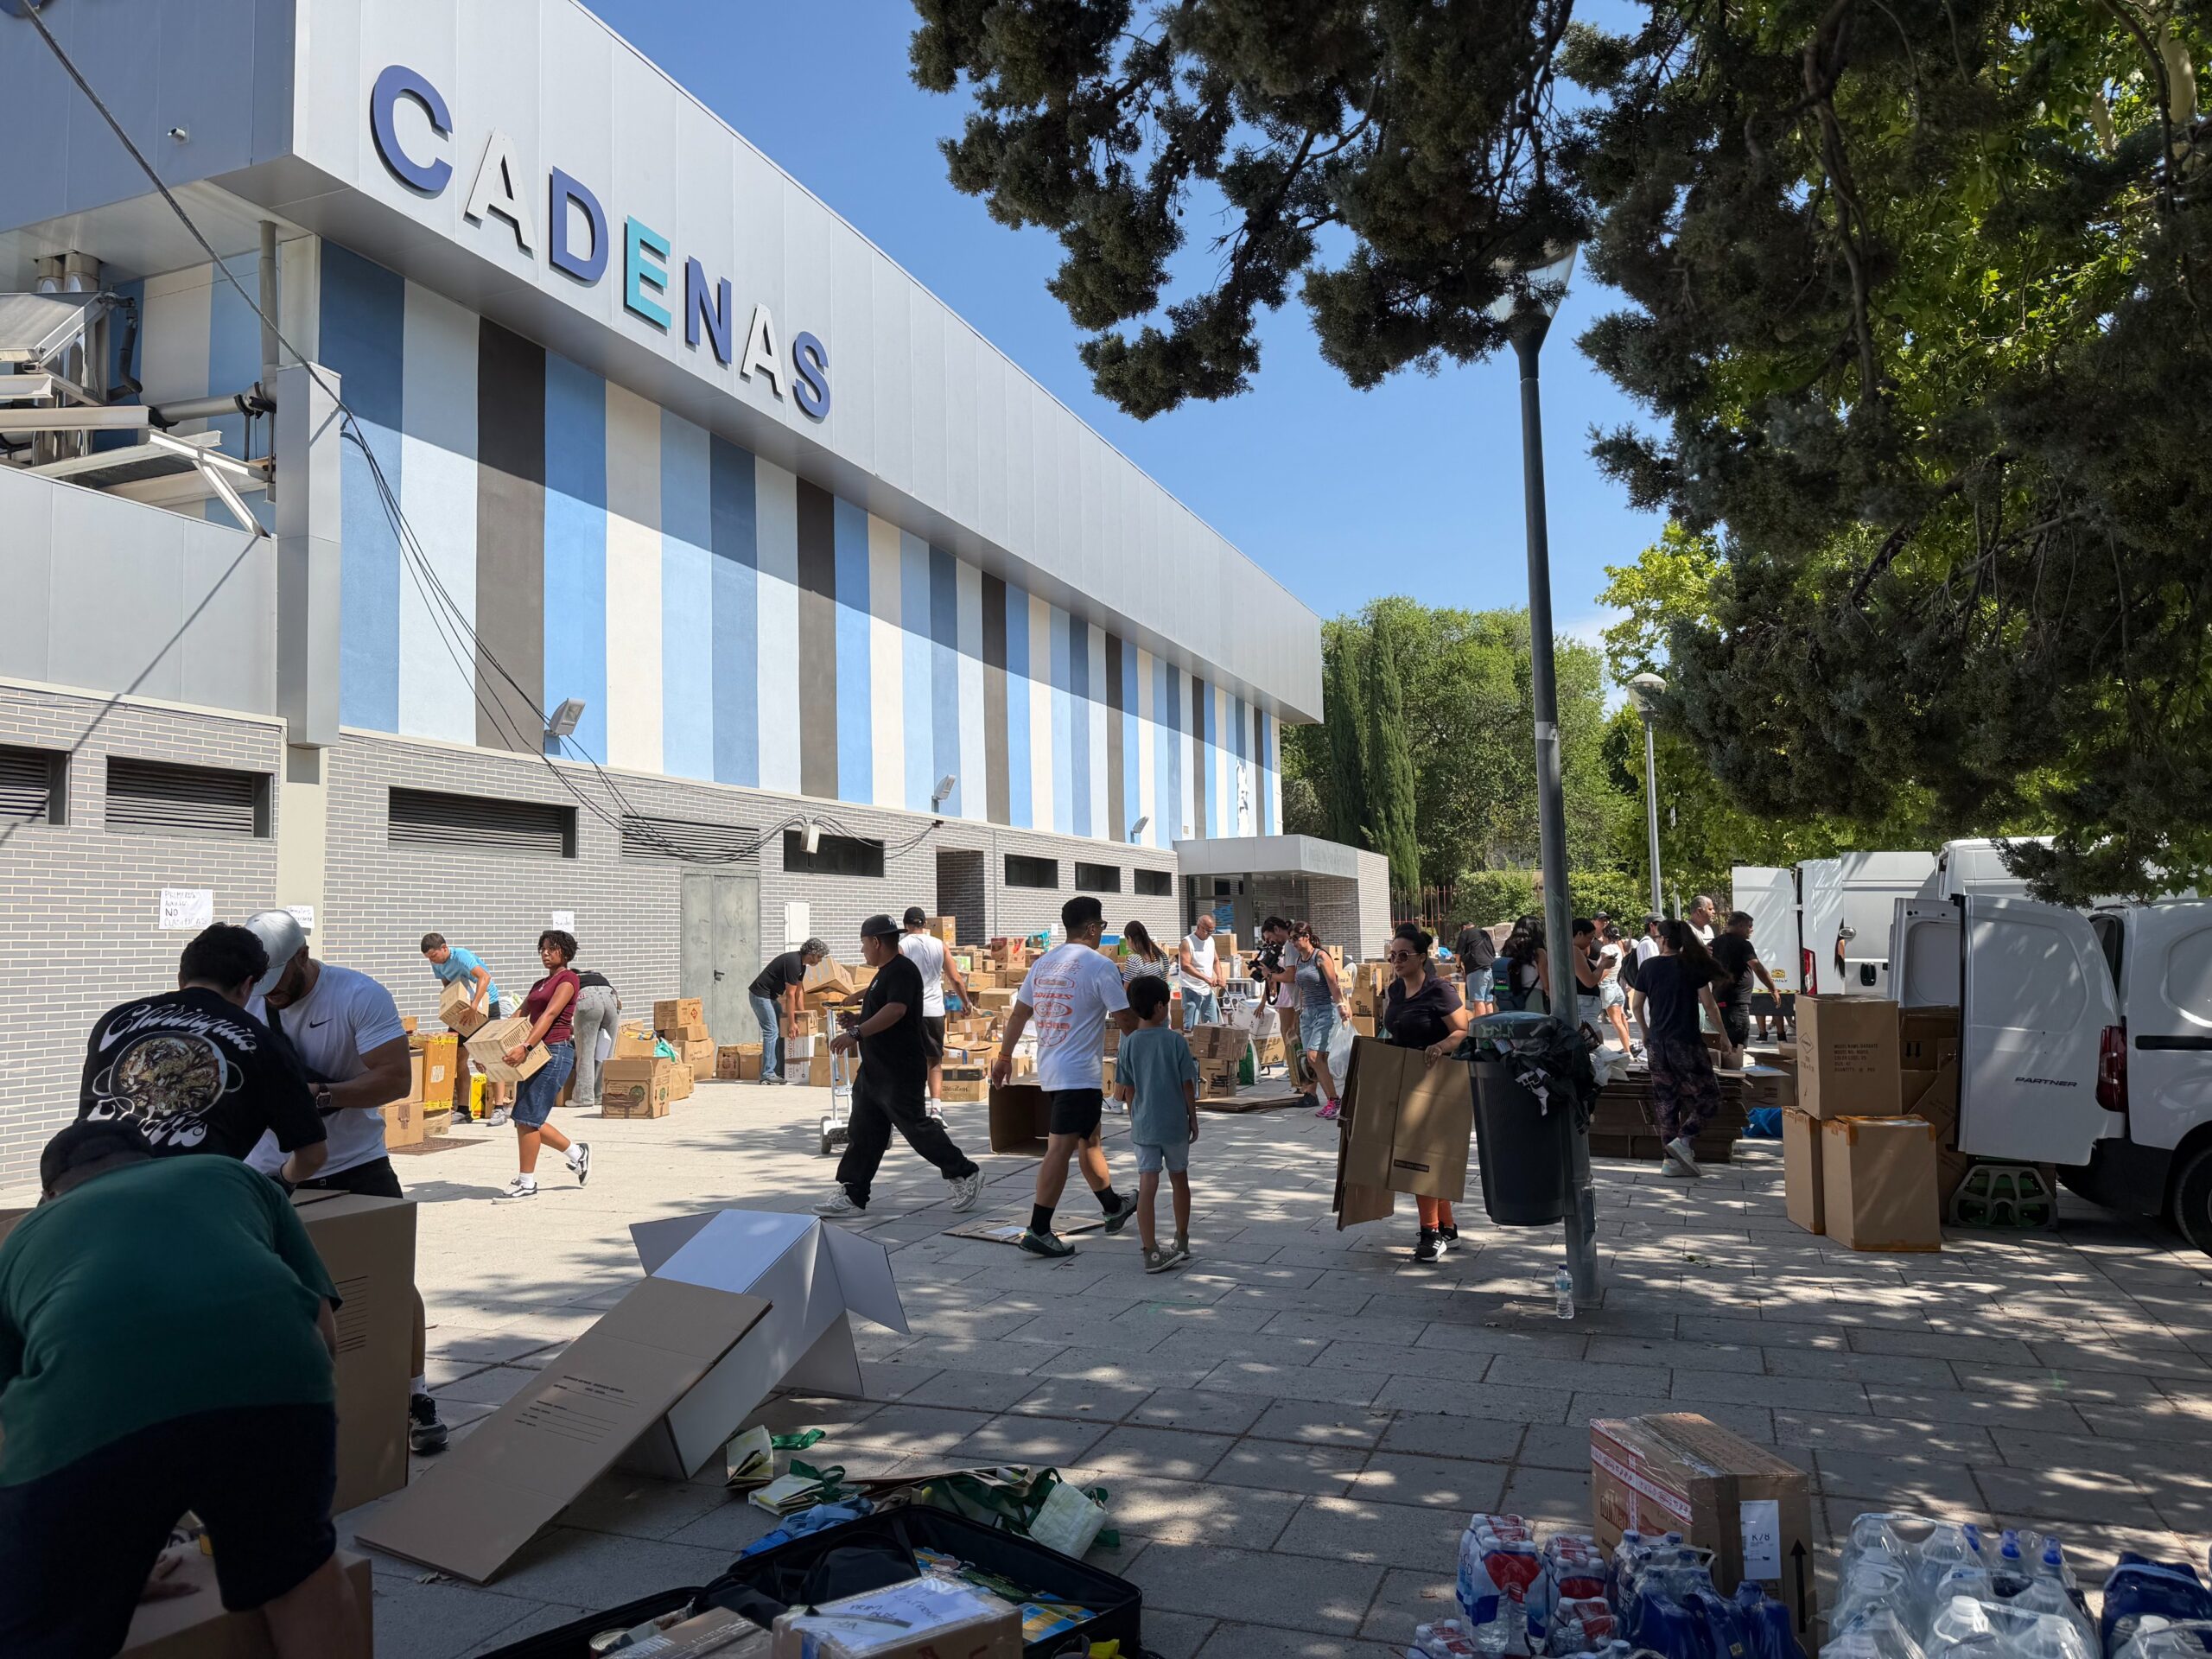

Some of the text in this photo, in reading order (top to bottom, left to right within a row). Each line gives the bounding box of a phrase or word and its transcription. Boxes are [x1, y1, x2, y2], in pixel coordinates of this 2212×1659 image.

[370, 65, 830, 418] CADENAS
[165, 907, 179, 917] NO
[2014, 1077, 2078, 1087] PARTNER
